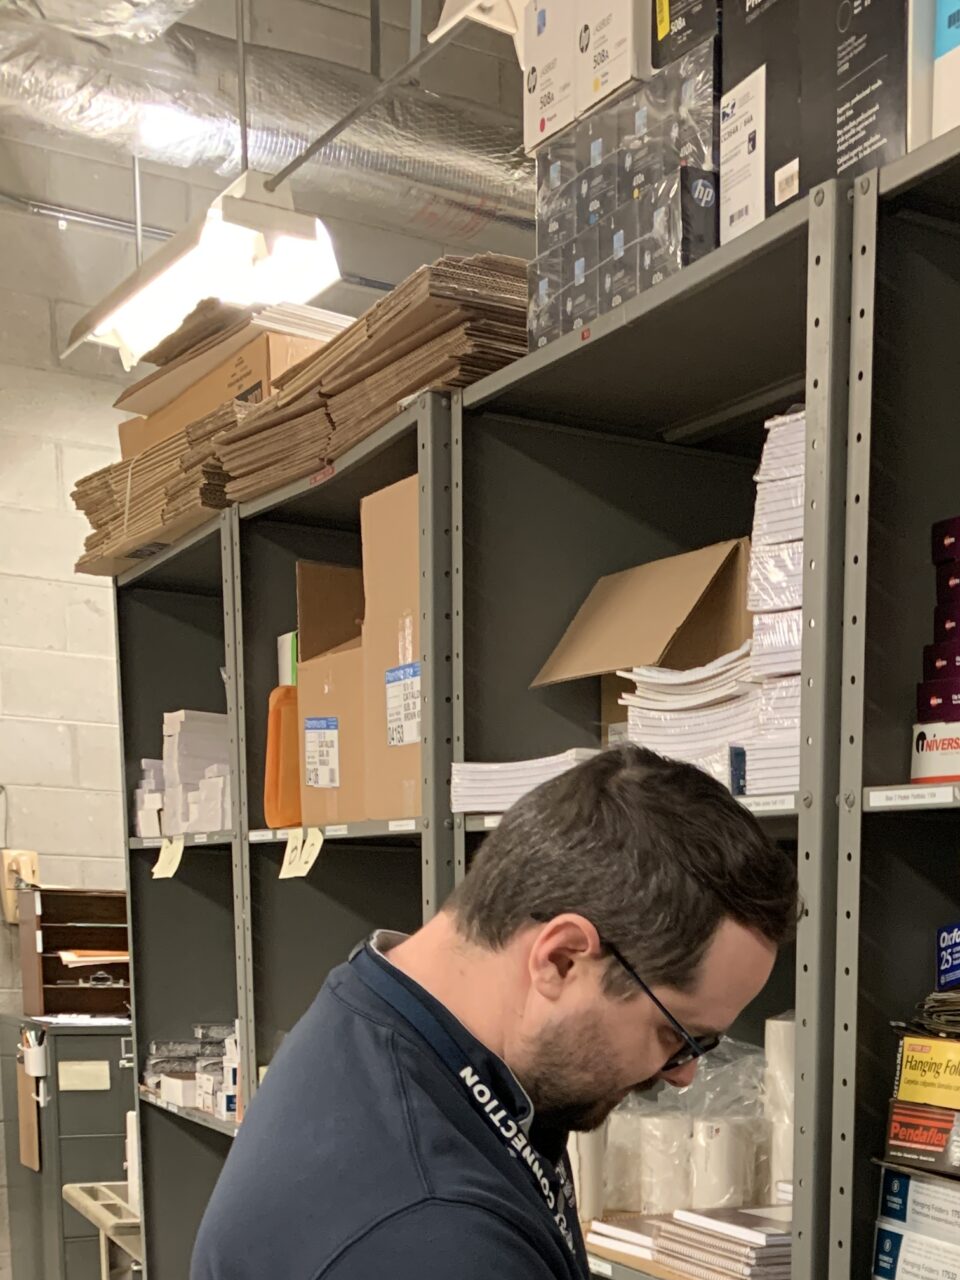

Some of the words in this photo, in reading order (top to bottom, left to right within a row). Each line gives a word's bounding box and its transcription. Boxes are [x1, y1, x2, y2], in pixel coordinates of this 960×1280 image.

[695, 183, 713, 207] hp
[941, 949, 952, 970] 25
[905, 1055, 942, 1078] Hanging
[459, 1066, 555, 1210] CONNECTION
[890, 1122, 948, 1146] Pendaflex
